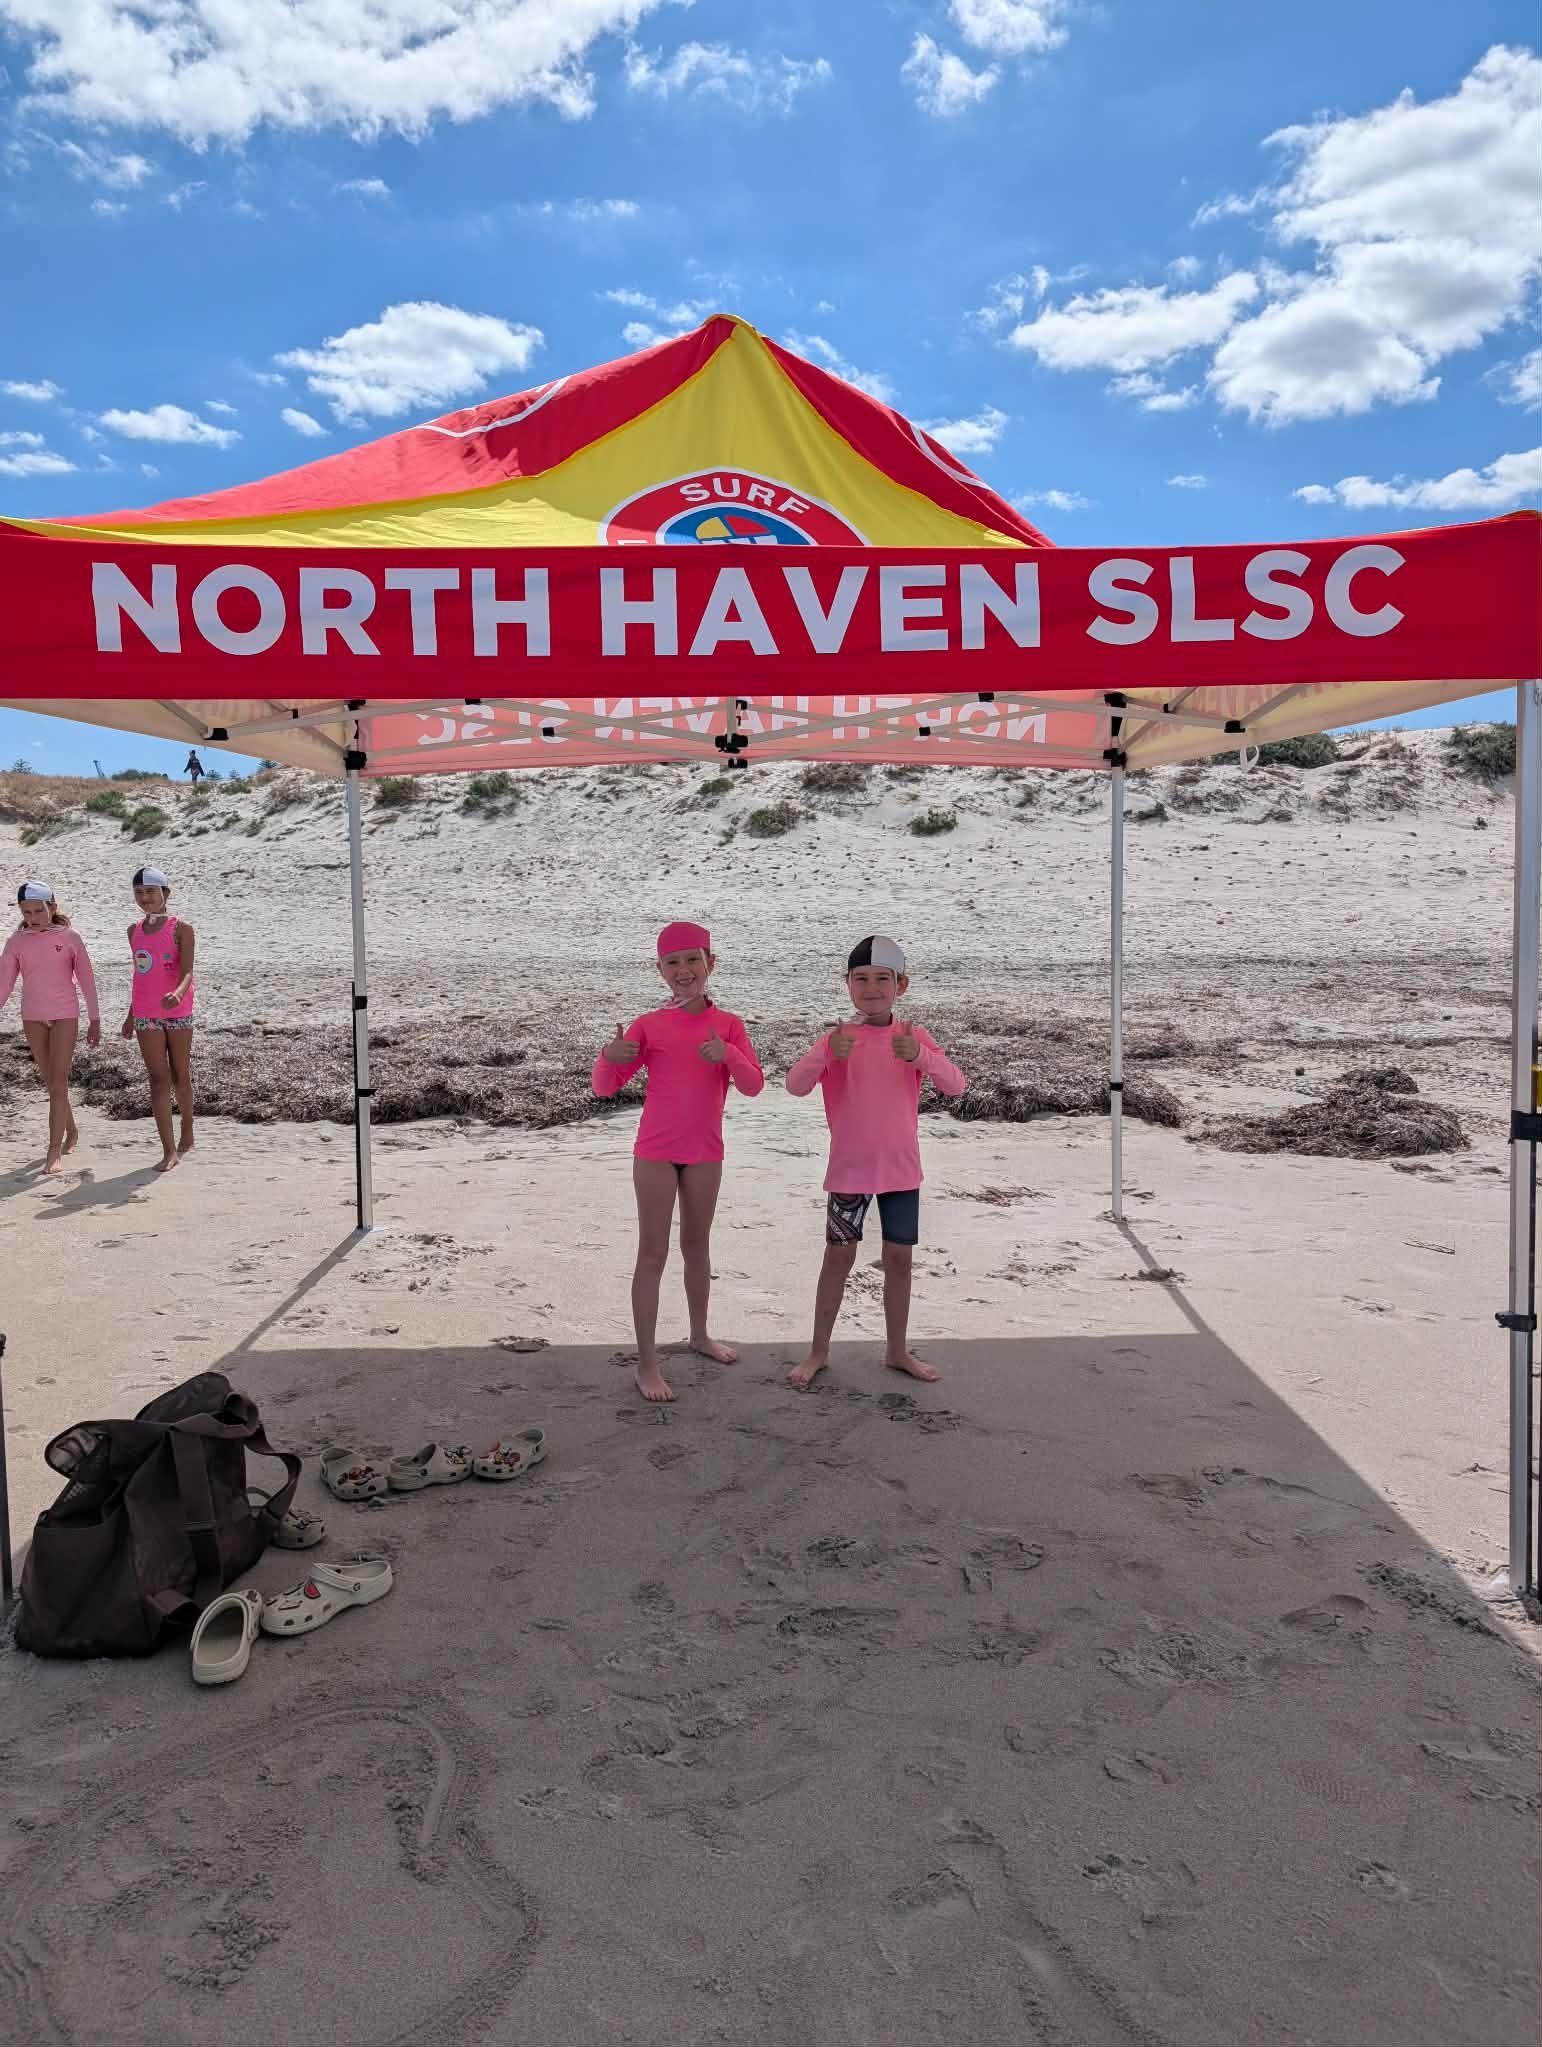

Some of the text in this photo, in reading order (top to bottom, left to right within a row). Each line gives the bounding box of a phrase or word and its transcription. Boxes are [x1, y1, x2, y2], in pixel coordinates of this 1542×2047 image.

[680, 477, 810, 515] SURF
[92, 544, 1406, 656] NORTH HAVEN SLSC
